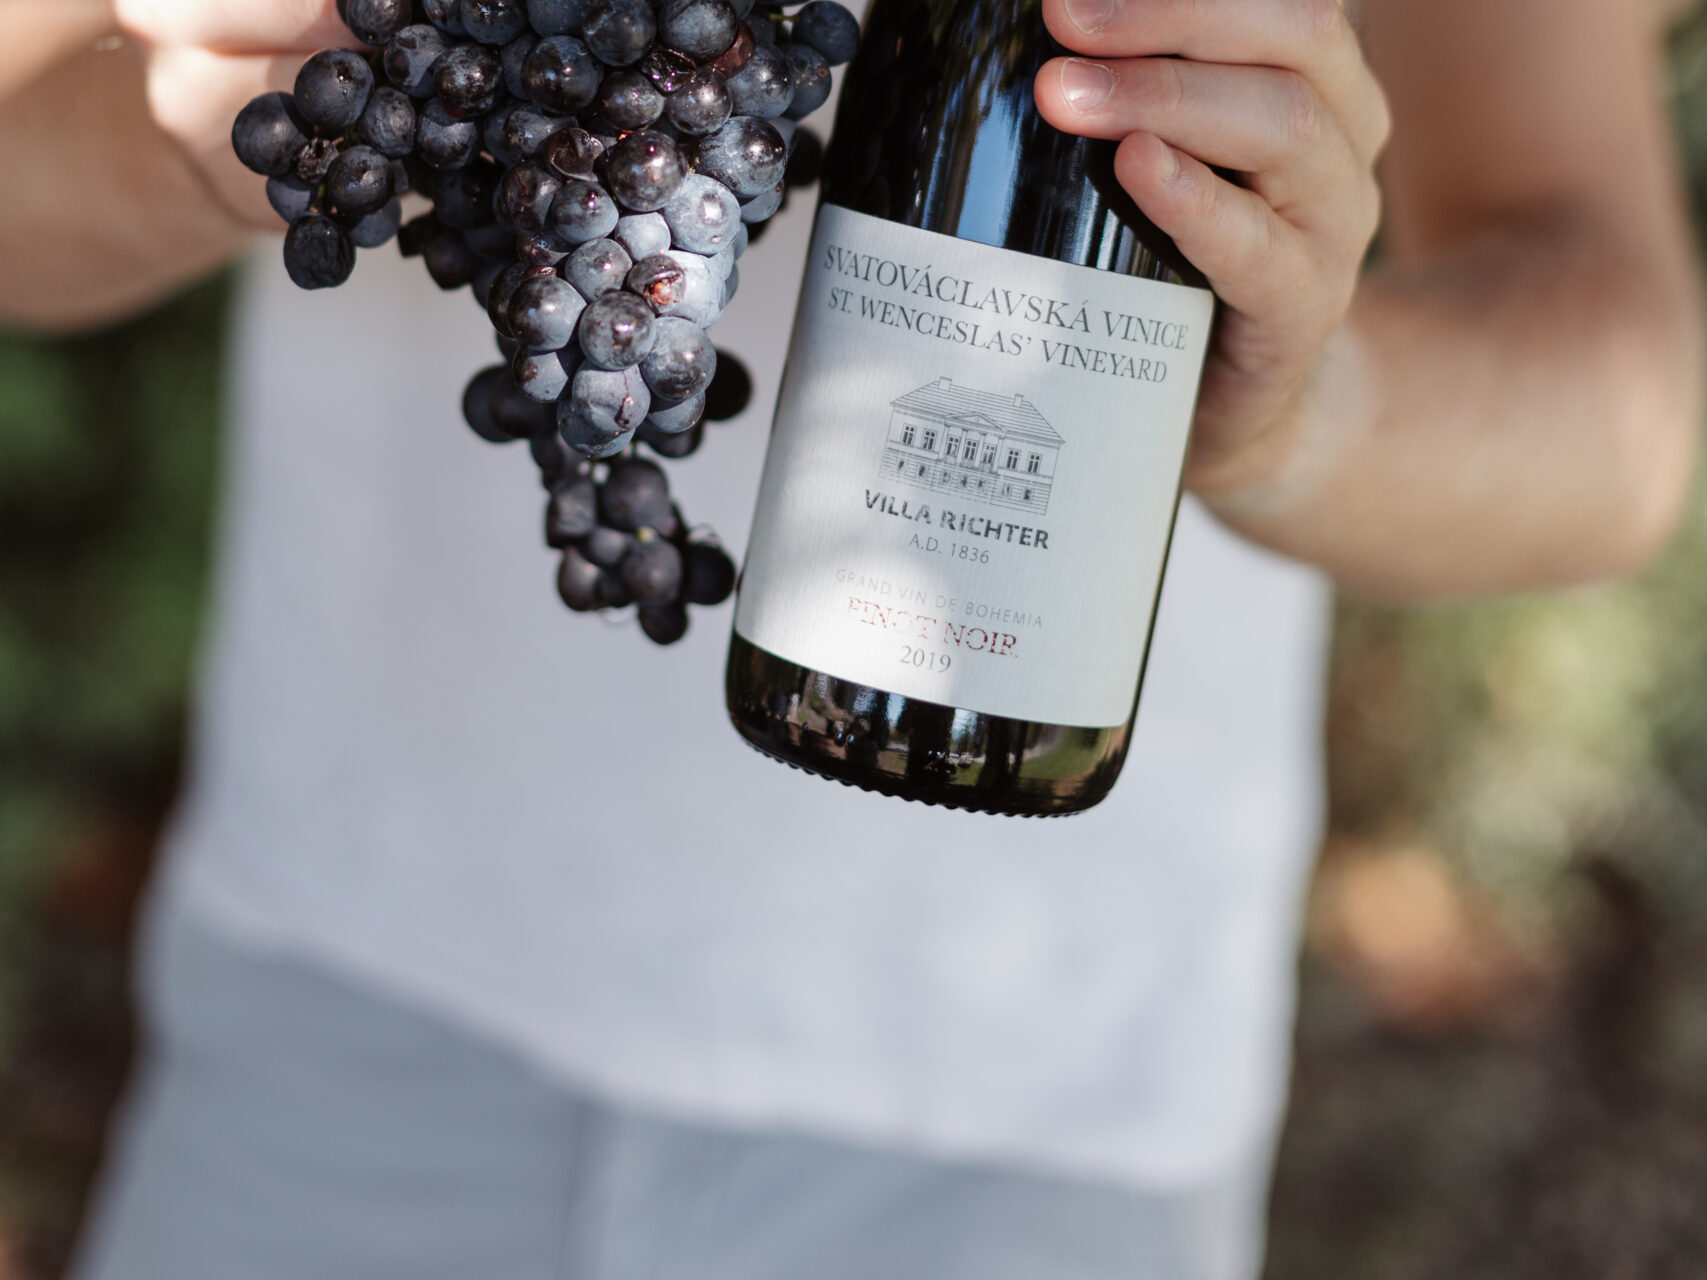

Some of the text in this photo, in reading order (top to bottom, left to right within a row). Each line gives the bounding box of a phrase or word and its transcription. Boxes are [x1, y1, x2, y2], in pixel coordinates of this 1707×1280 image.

[823, 244, 1190, 351] SVATOVÁCLAVSKÁ VINICE
[827, 286, 853, 314] ST.
[1040, 338, 1168, 384] VINEYARD
[864, 488, 1050, 550] VILLA RICHTER
[908, 533, 990, 565] A.D. 1836
[835, 568, 1043, 629] GRAND VIN DE BOHEMIA
[848, 595, 1019, 658] PINOT NOIR
[899, 644, 952, 673] 2019
